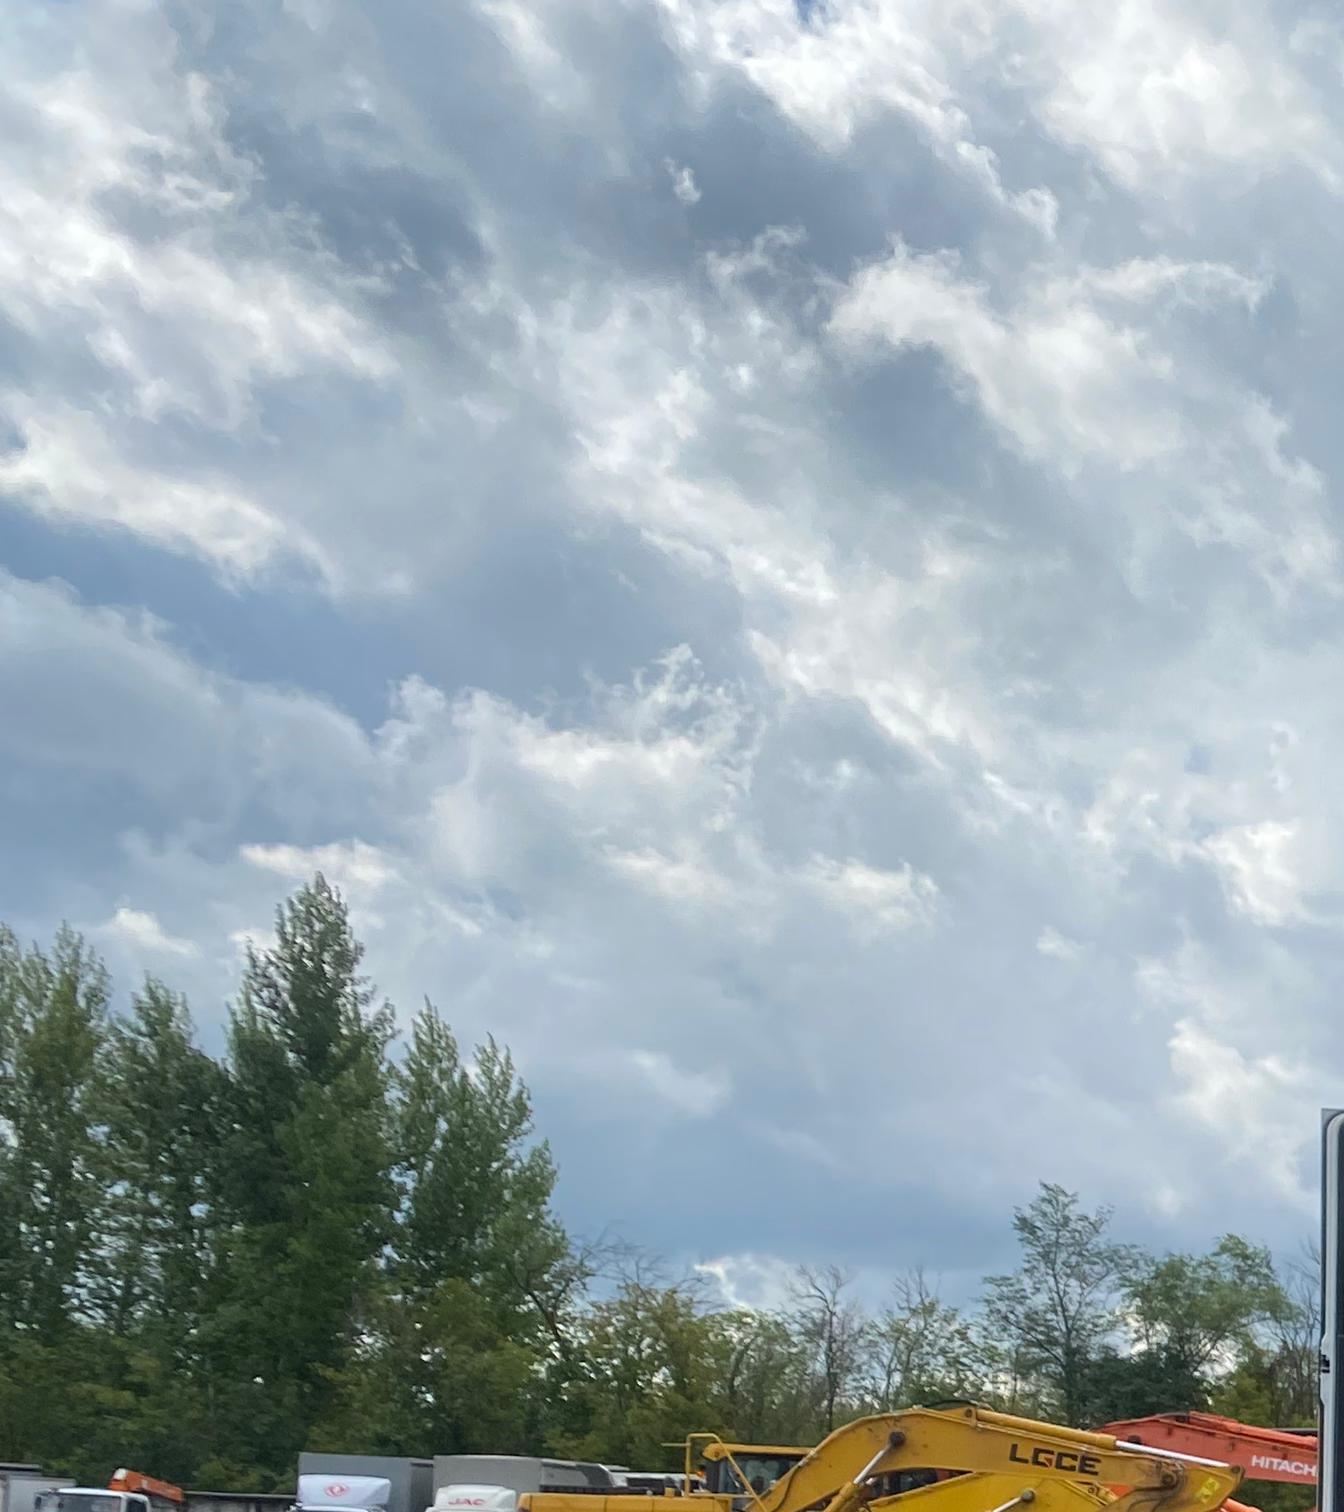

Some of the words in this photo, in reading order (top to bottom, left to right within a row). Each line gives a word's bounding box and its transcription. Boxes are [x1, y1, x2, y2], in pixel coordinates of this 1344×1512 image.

[1009, 1443, 1102, 1476] LGCE
[1251, 1454, 1318, 1477] HITACH
[447, 1497, 487, 1506] JAC
